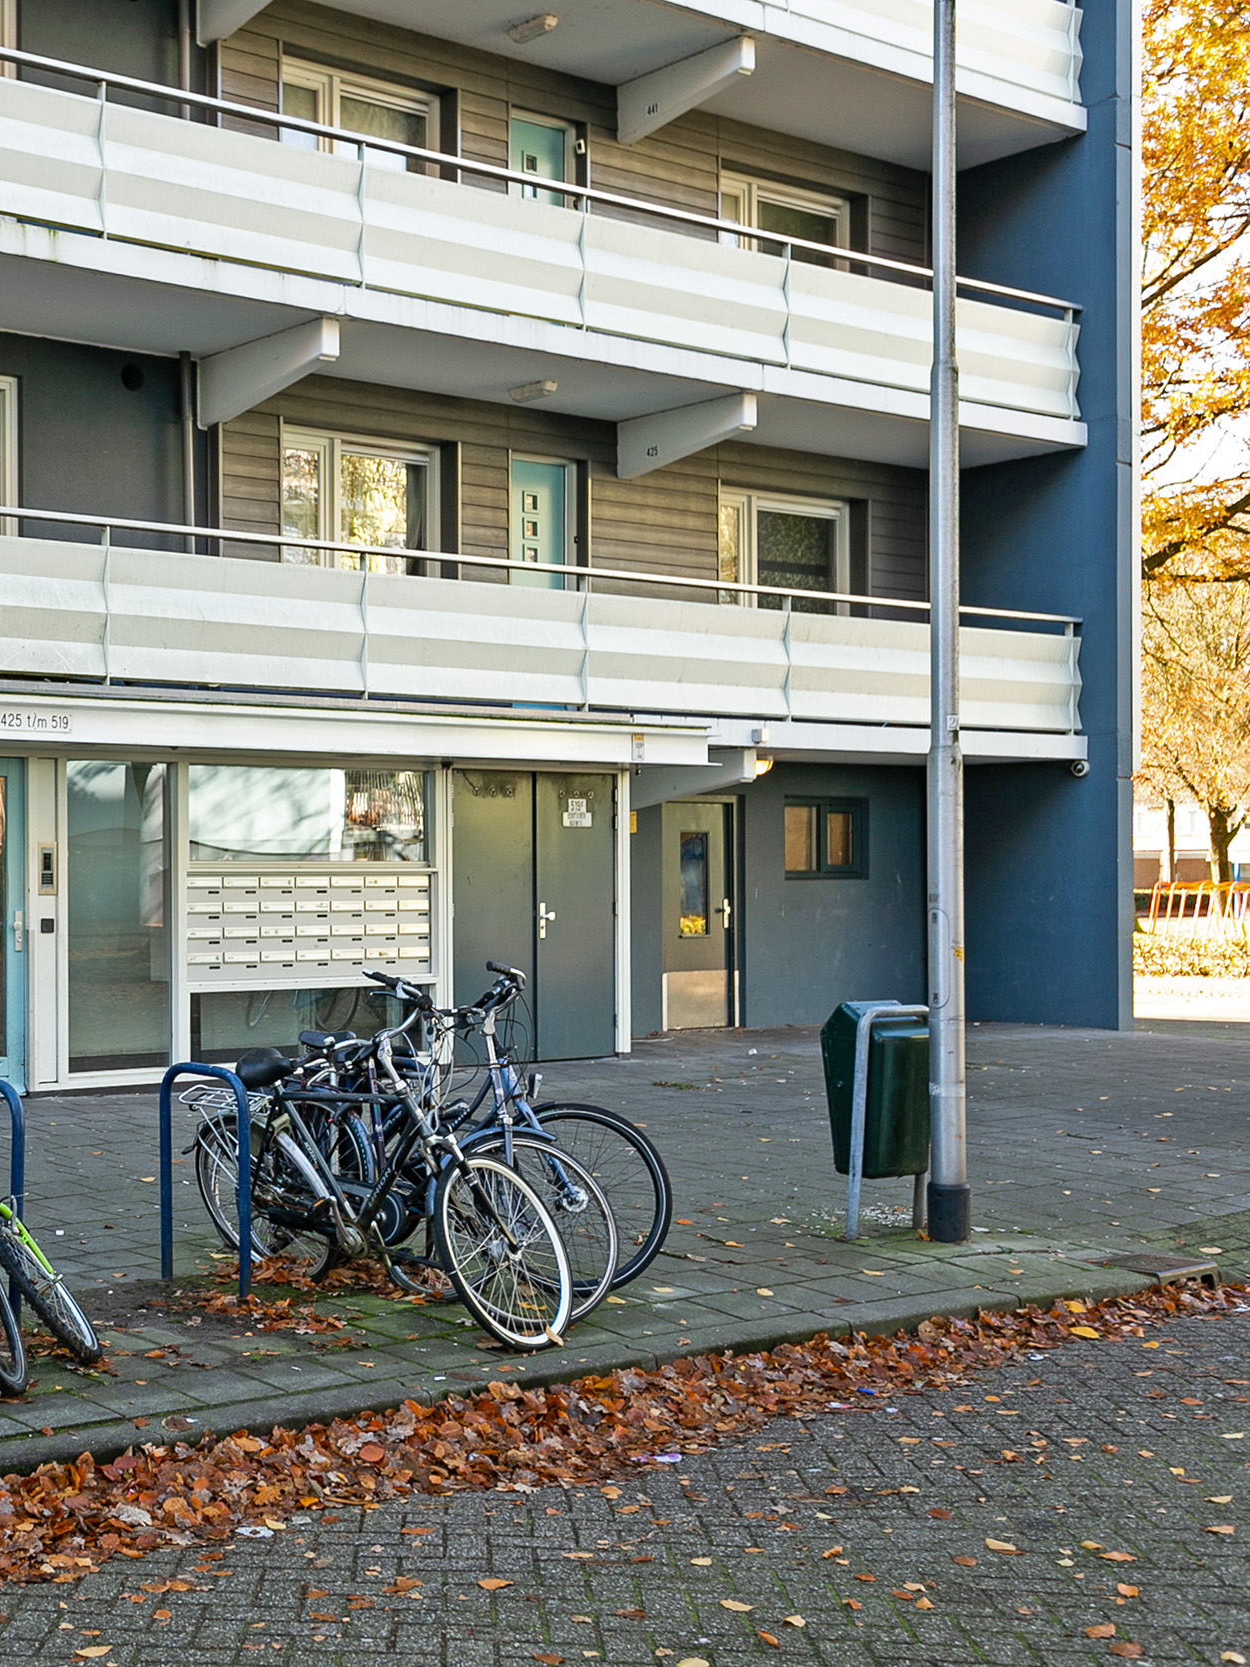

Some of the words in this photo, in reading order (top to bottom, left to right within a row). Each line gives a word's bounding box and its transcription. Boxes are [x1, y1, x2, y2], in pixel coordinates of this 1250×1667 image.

[647, 445, 658, 457] 425
[0, 713, 22, 727] 425
[27, 713, 47, 728] t/m
[51, 715, 69, 729] 519
[368, 1167, 391, 1207] UNION
